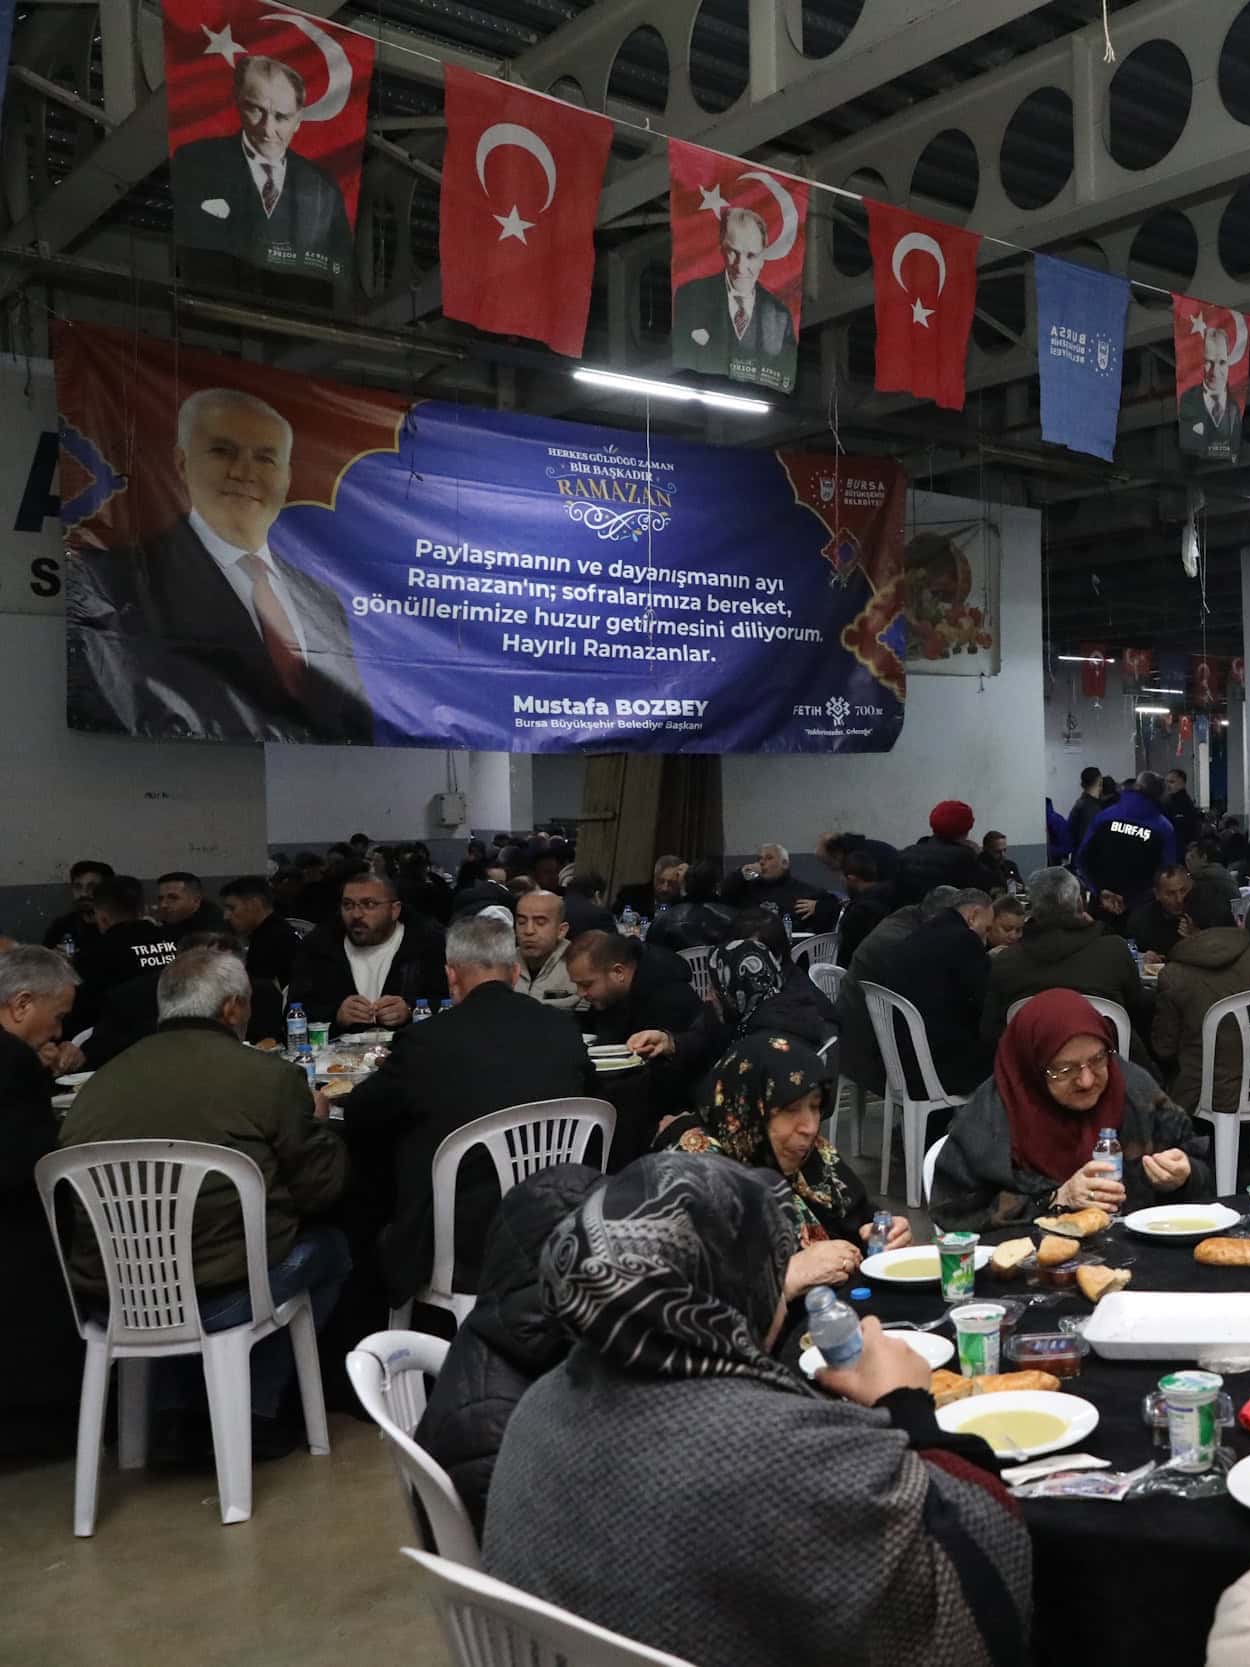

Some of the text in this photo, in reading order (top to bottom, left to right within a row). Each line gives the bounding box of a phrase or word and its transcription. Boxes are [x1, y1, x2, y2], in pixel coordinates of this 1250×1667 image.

[548, 447, 588, 461] HERKES
[638, 459, 674, 471] ZAMAN
[570, 462, 653, 481] BİR BAŞKADIR
[556, 478, 673, 508] RAMAZAN
[846, 478, 885, 490] BURSA
[415, 538, 785, 594] Paylaşmanın ve dayanışmanın ayı
[408, 567, 793, 618] Ramazan'ın; sofralarımıza bereket,
[351, 593, 824, 643] gönüllerimize huzur getirmesini diliyorum.
[502, 633, 717, 662] Hayırlı Ramazanlar.
[513, 695, 710, 717] Mustafa BOZBEY
[515, 718, 703, 732] Bursa Büyükşehir Belediye Başkanı
[1110, 820, 1152, 842] BURFAŞ
[130, 940, 177, 955] TRAFİK
